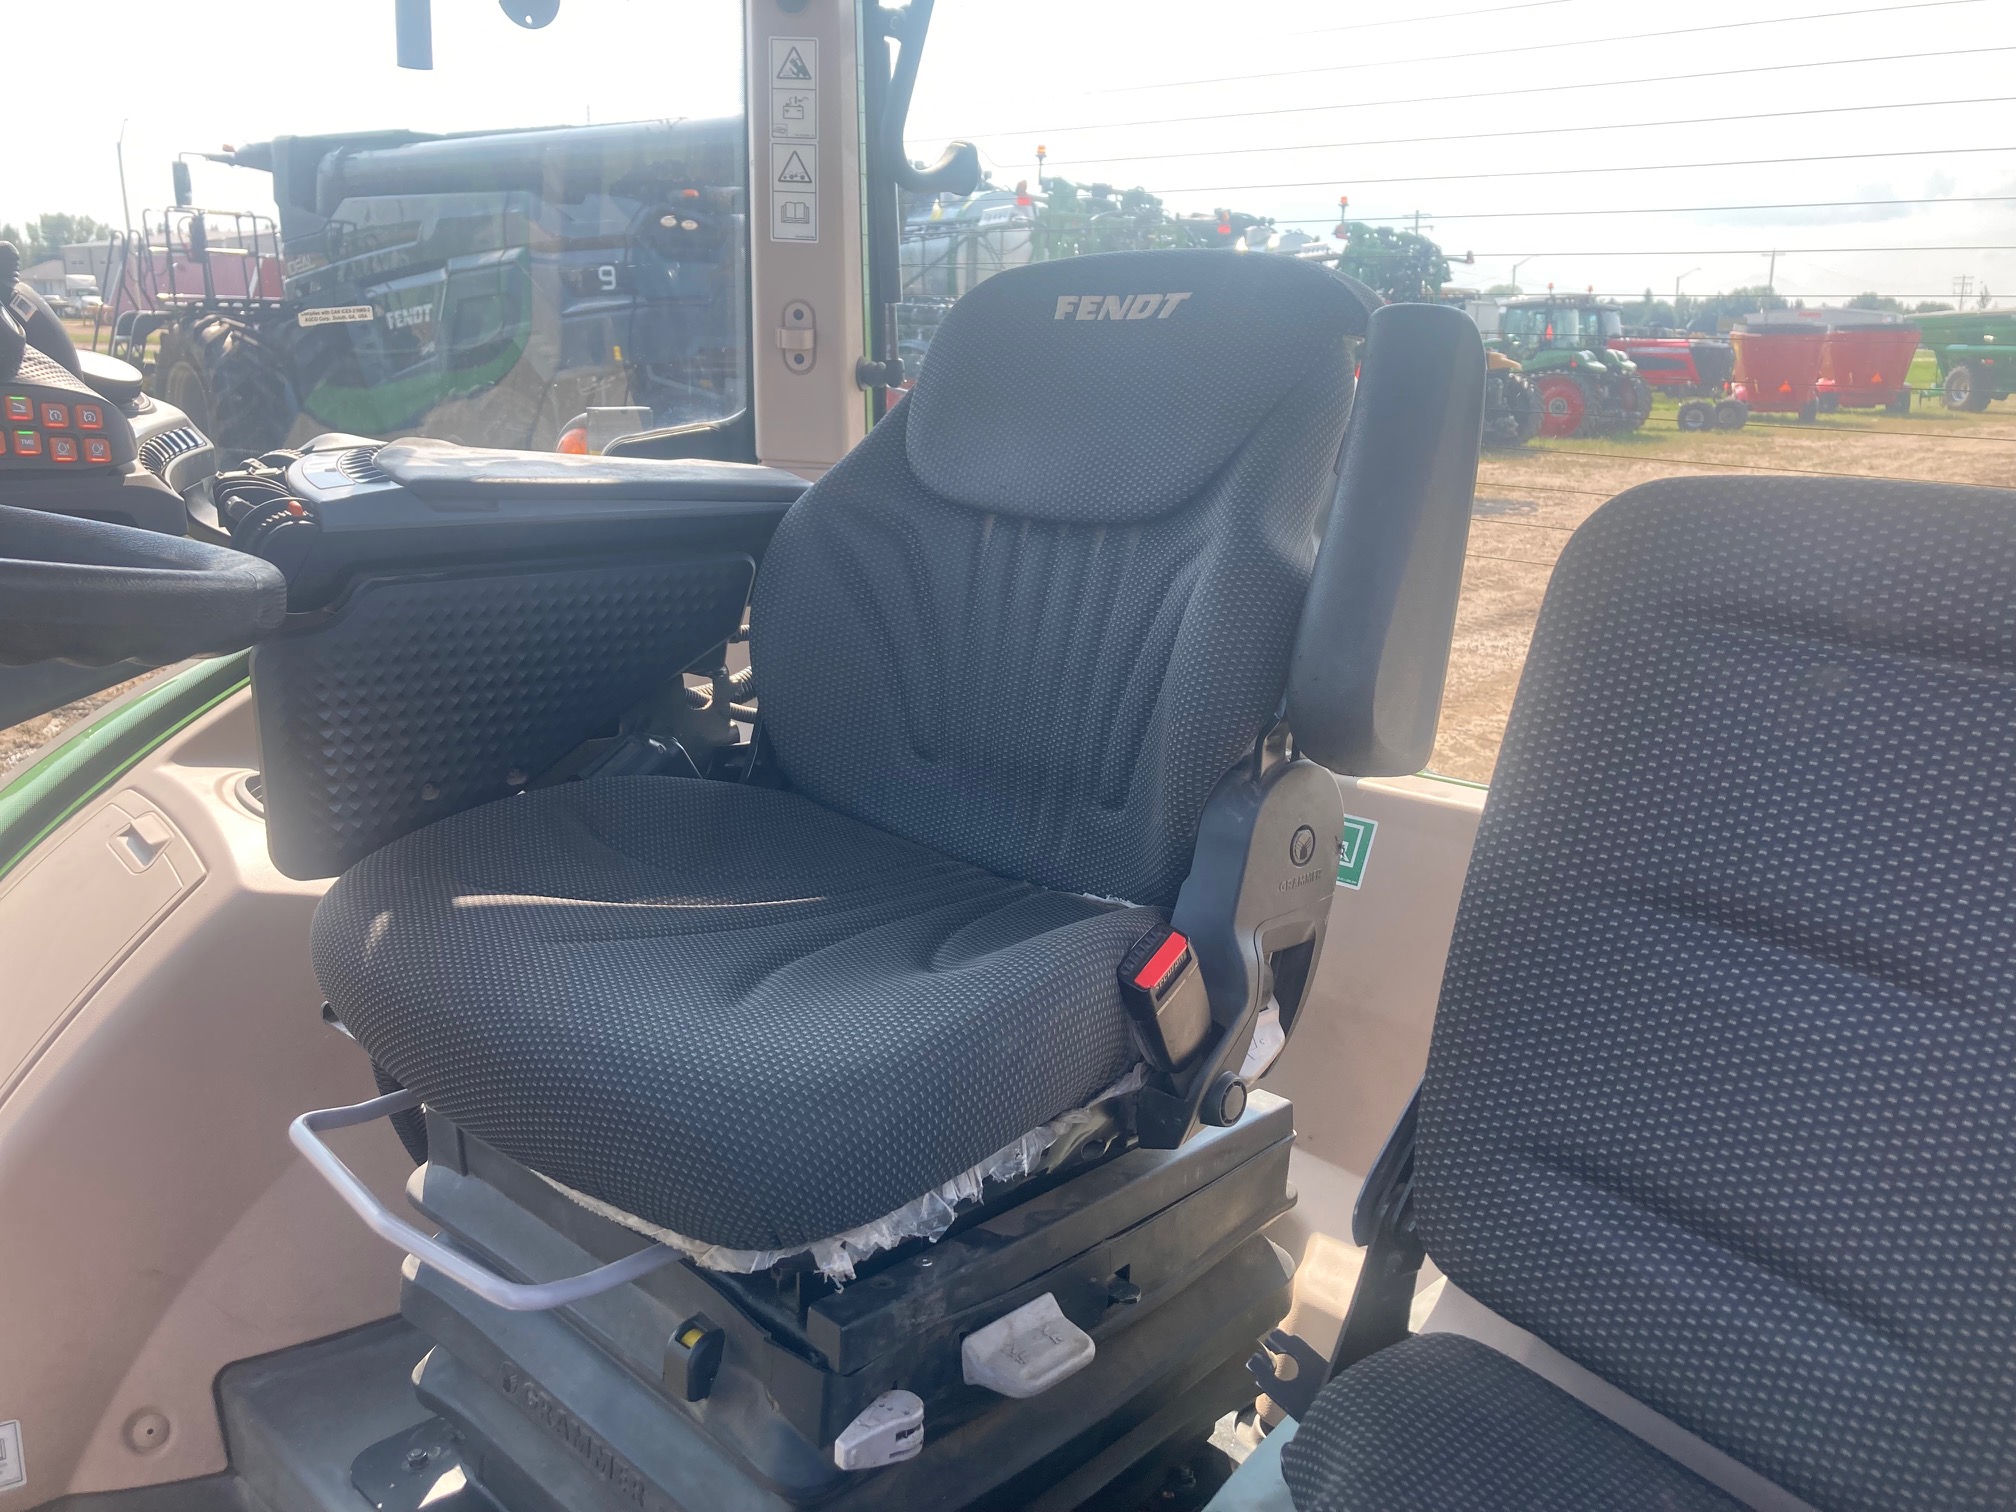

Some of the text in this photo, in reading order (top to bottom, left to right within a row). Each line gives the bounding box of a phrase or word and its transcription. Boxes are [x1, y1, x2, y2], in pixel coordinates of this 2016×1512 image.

[598, 265, 616, 291] 9
[385, 303, 433, 330] FENDT
[1054, 291, 1194, 320] FENDT
[1279, 868, 1322, 892] GRAMMER
[523, 1381, 647, 1508] GRAMMER
